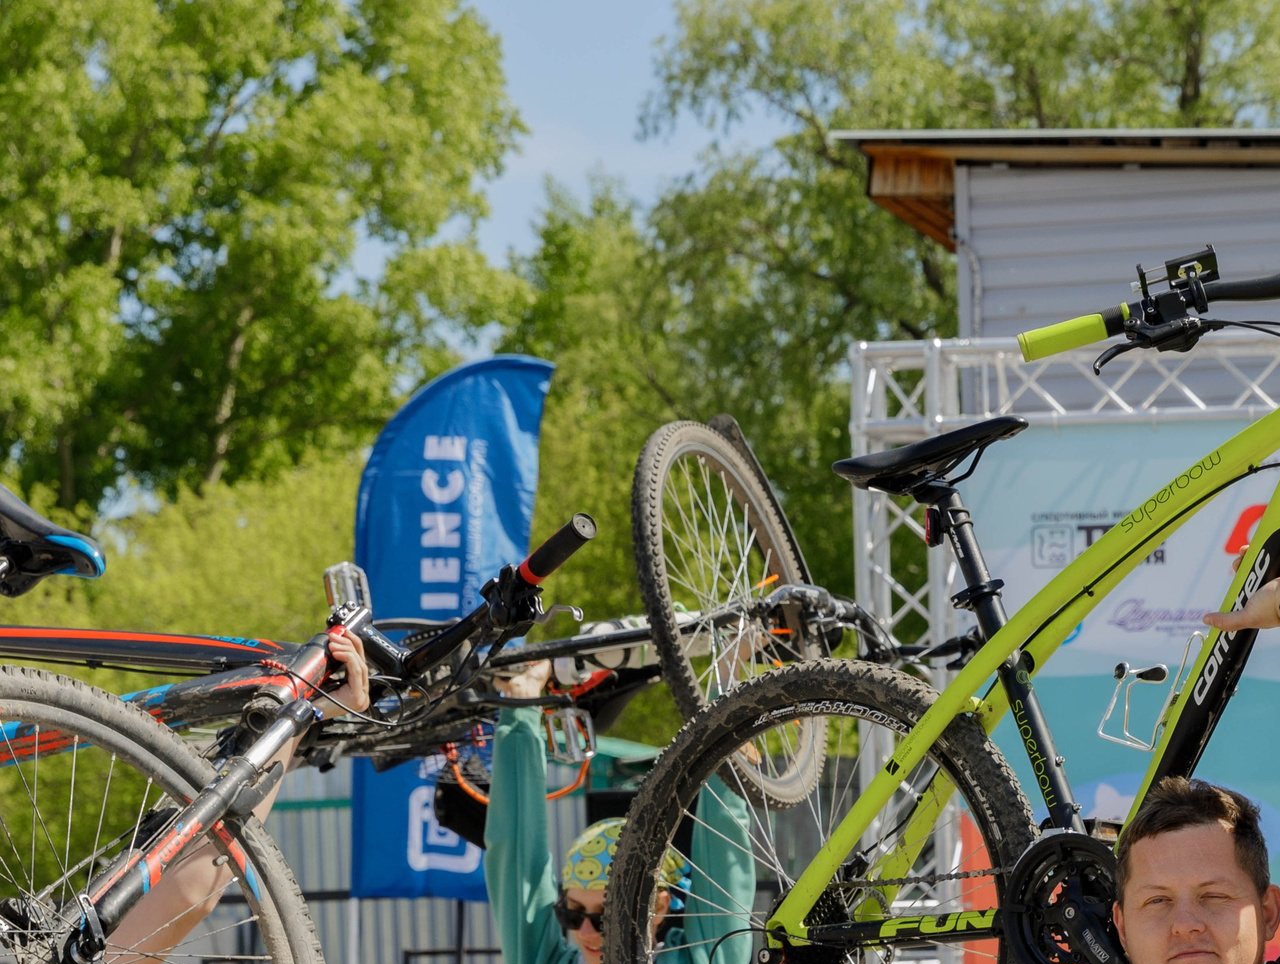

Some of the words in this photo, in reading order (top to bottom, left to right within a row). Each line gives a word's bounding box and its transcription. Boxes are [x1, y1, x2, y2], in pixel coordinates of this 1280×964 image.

[419, 435, 466, 610] IENCE
[1011, 699, 1058, 808] superbow
[879, 909, 996, 938] FUN
